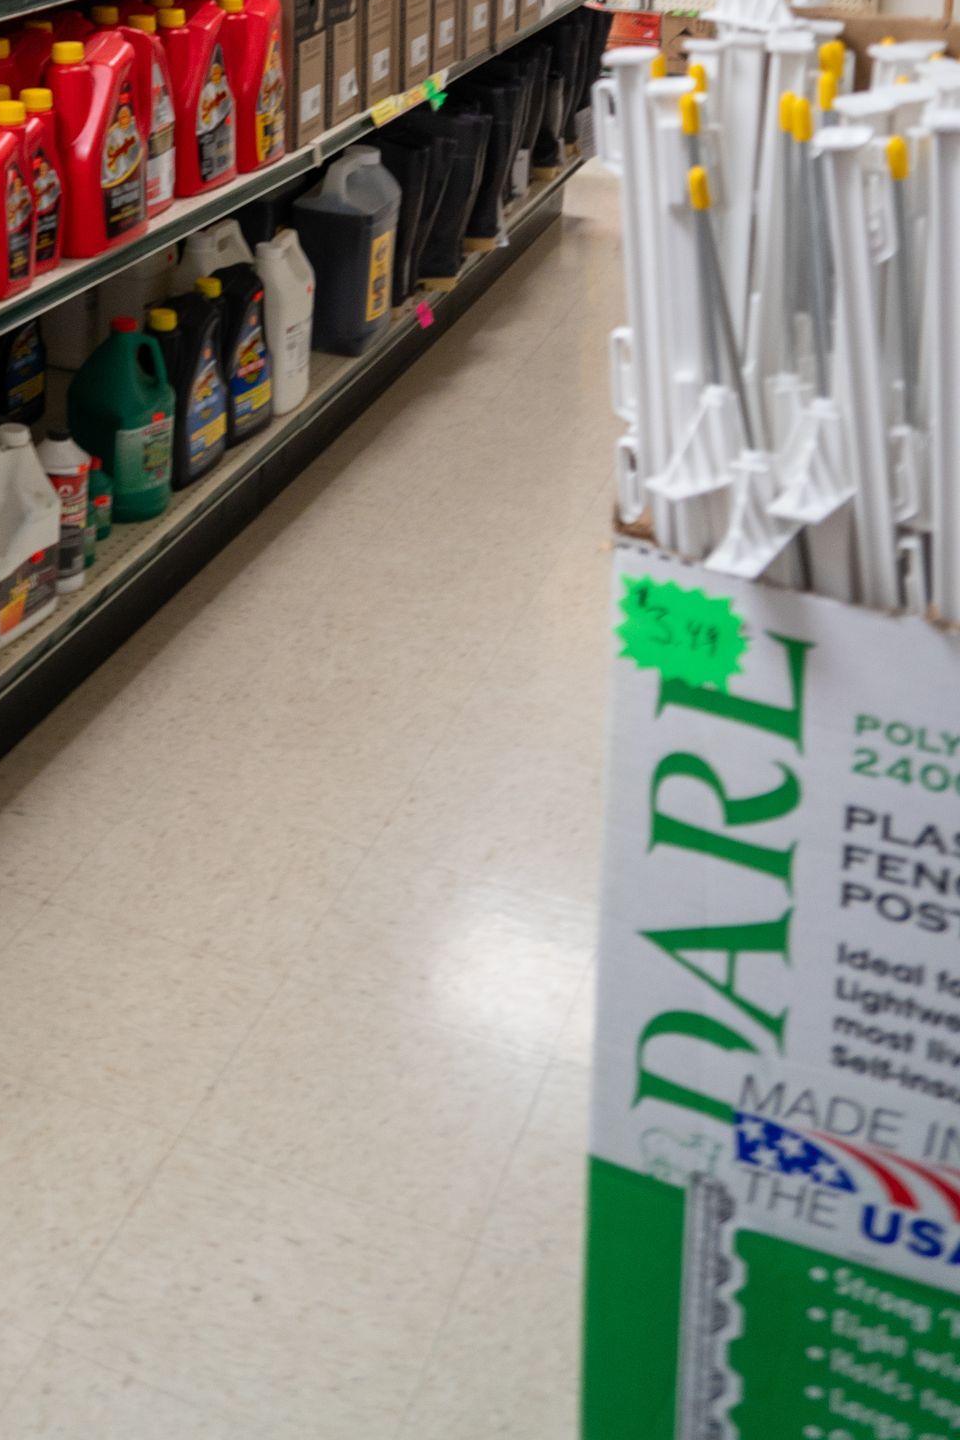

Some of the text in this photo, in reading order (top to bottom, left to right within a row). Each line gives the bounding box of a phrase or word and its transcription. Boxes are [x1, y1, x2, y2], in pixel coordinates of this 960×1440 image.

[841, 844, 960, 895] FEN
[837, 942, 925, 986] Ideal
[832, 1016, 915, 1053] most
[739, 1073, 906, 1150] MADE
[740, 1166, 841, 1230] THE
